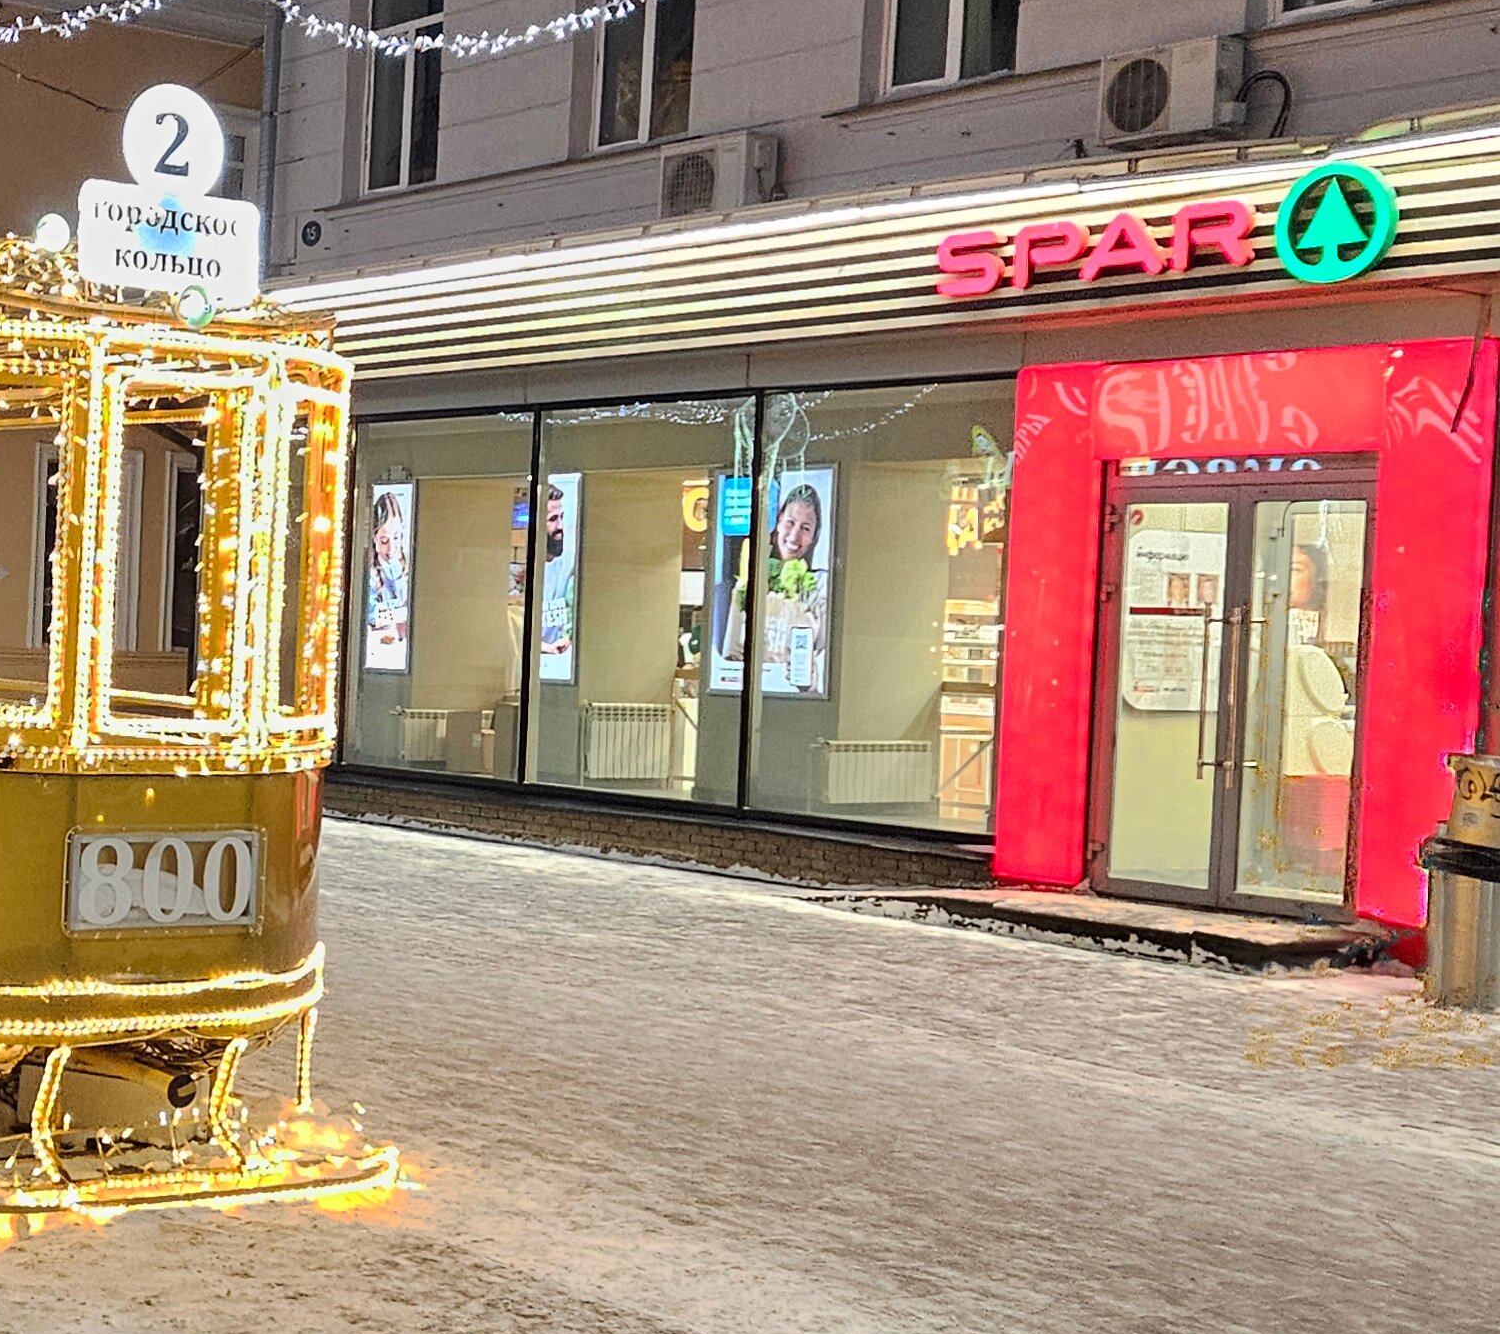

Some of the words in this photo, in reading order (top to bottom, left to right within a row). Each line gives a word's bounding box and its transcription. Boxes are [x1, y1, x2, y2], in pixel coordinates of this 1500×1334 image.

[153, 112, 191, 177] 2
[114, 247, 222, 279] кольцо
[936, 200, 1257, 299] SPAR
[78, 836, 251, 926] 800
